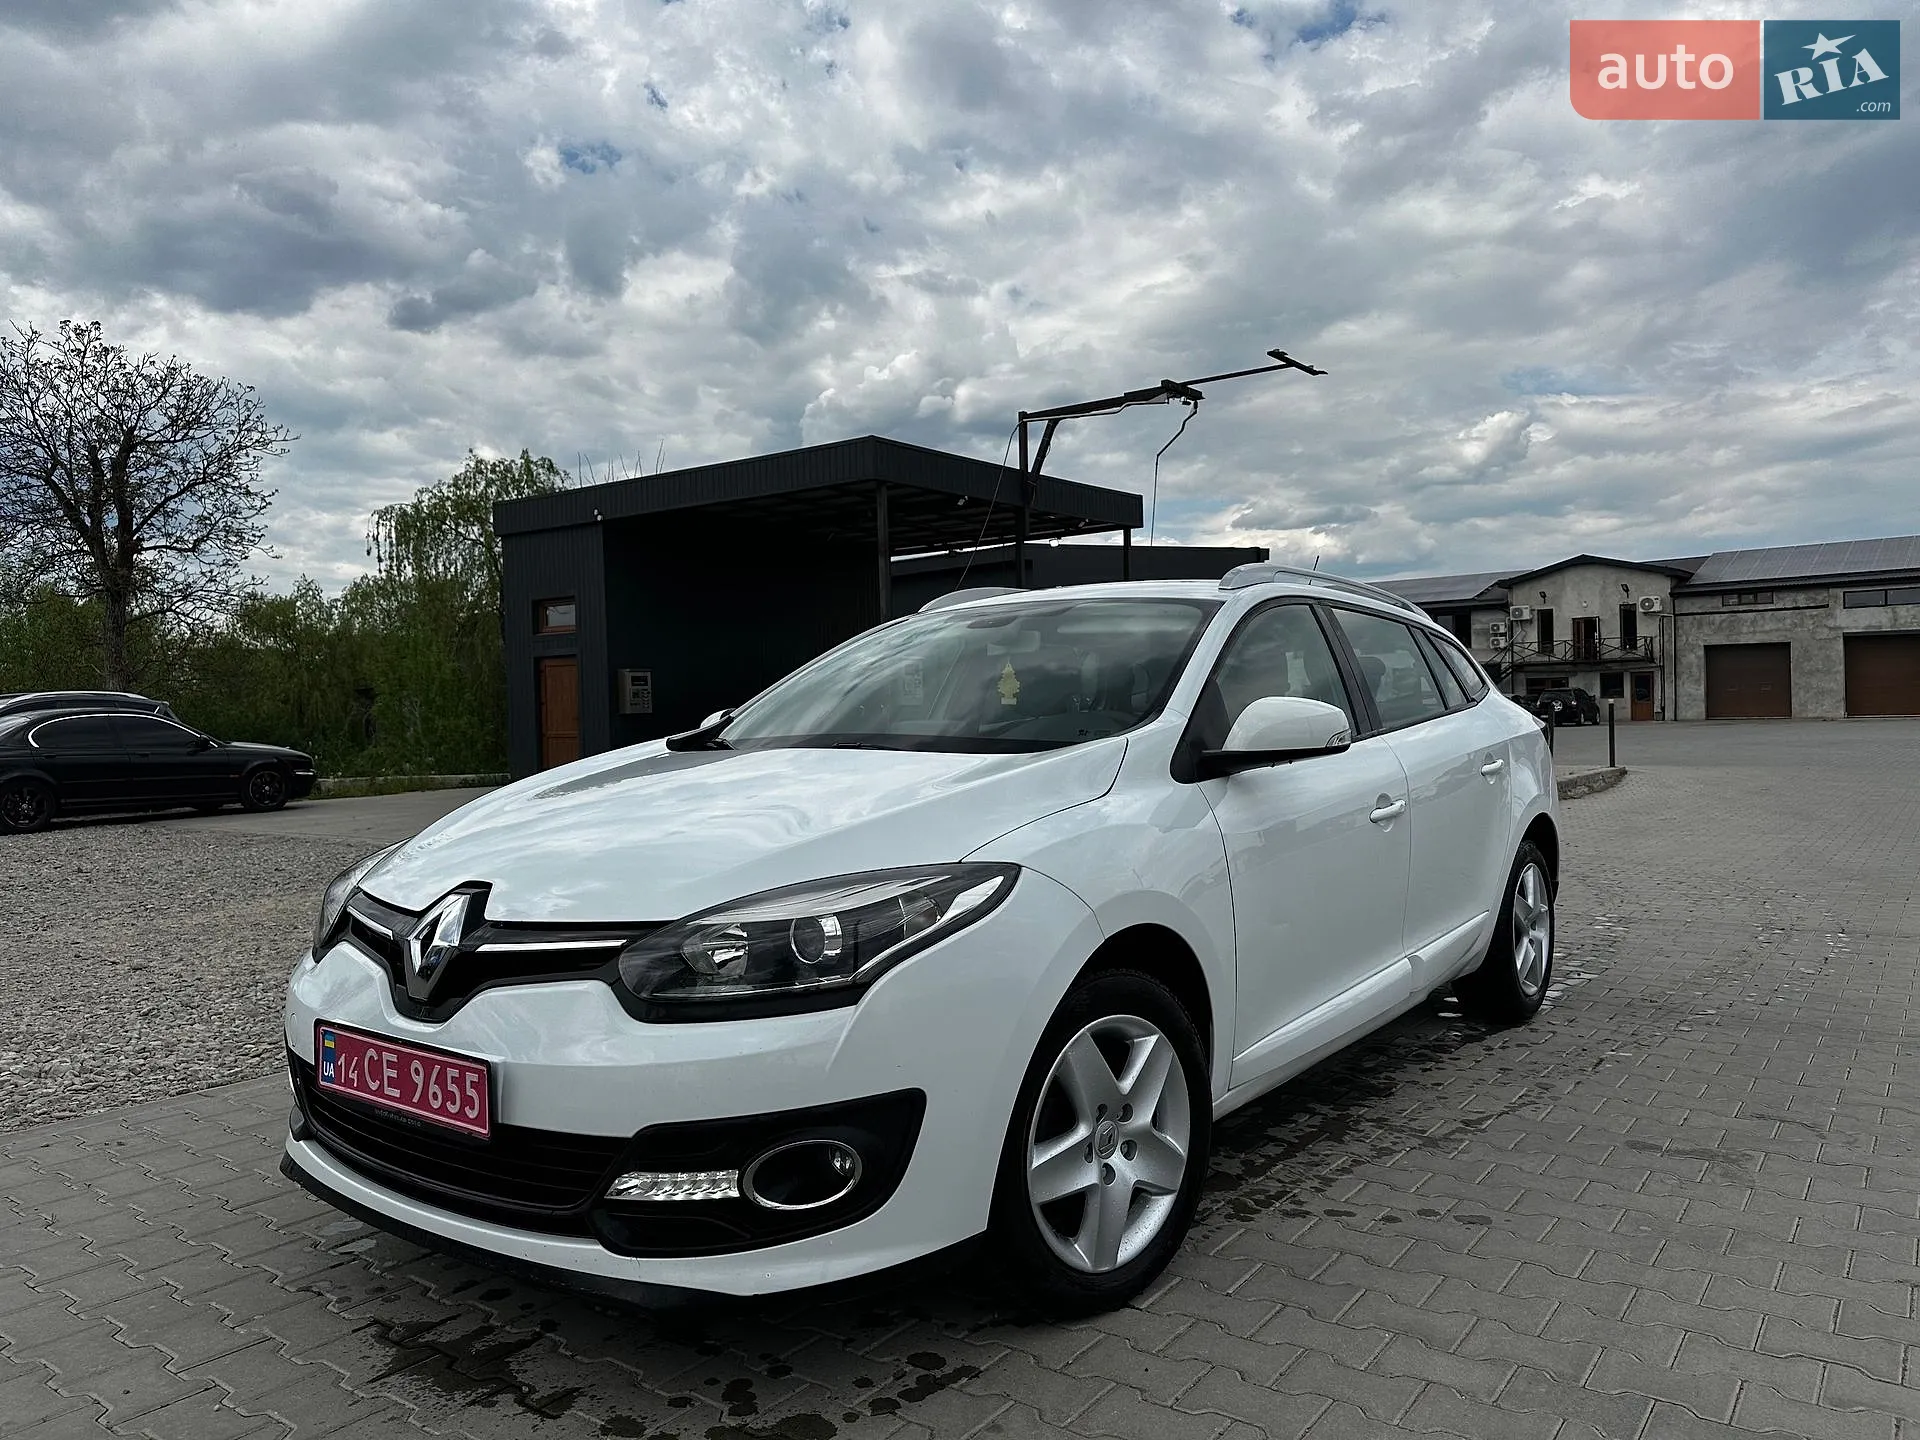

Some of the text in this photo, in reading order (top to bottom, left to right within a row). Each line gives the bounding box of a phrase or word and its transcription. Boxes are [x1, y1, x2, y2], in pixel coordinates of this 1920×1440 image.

[323, 1060, 335, 1078] UA
[338, 1048, 480, 1119] 14 CE 9655
